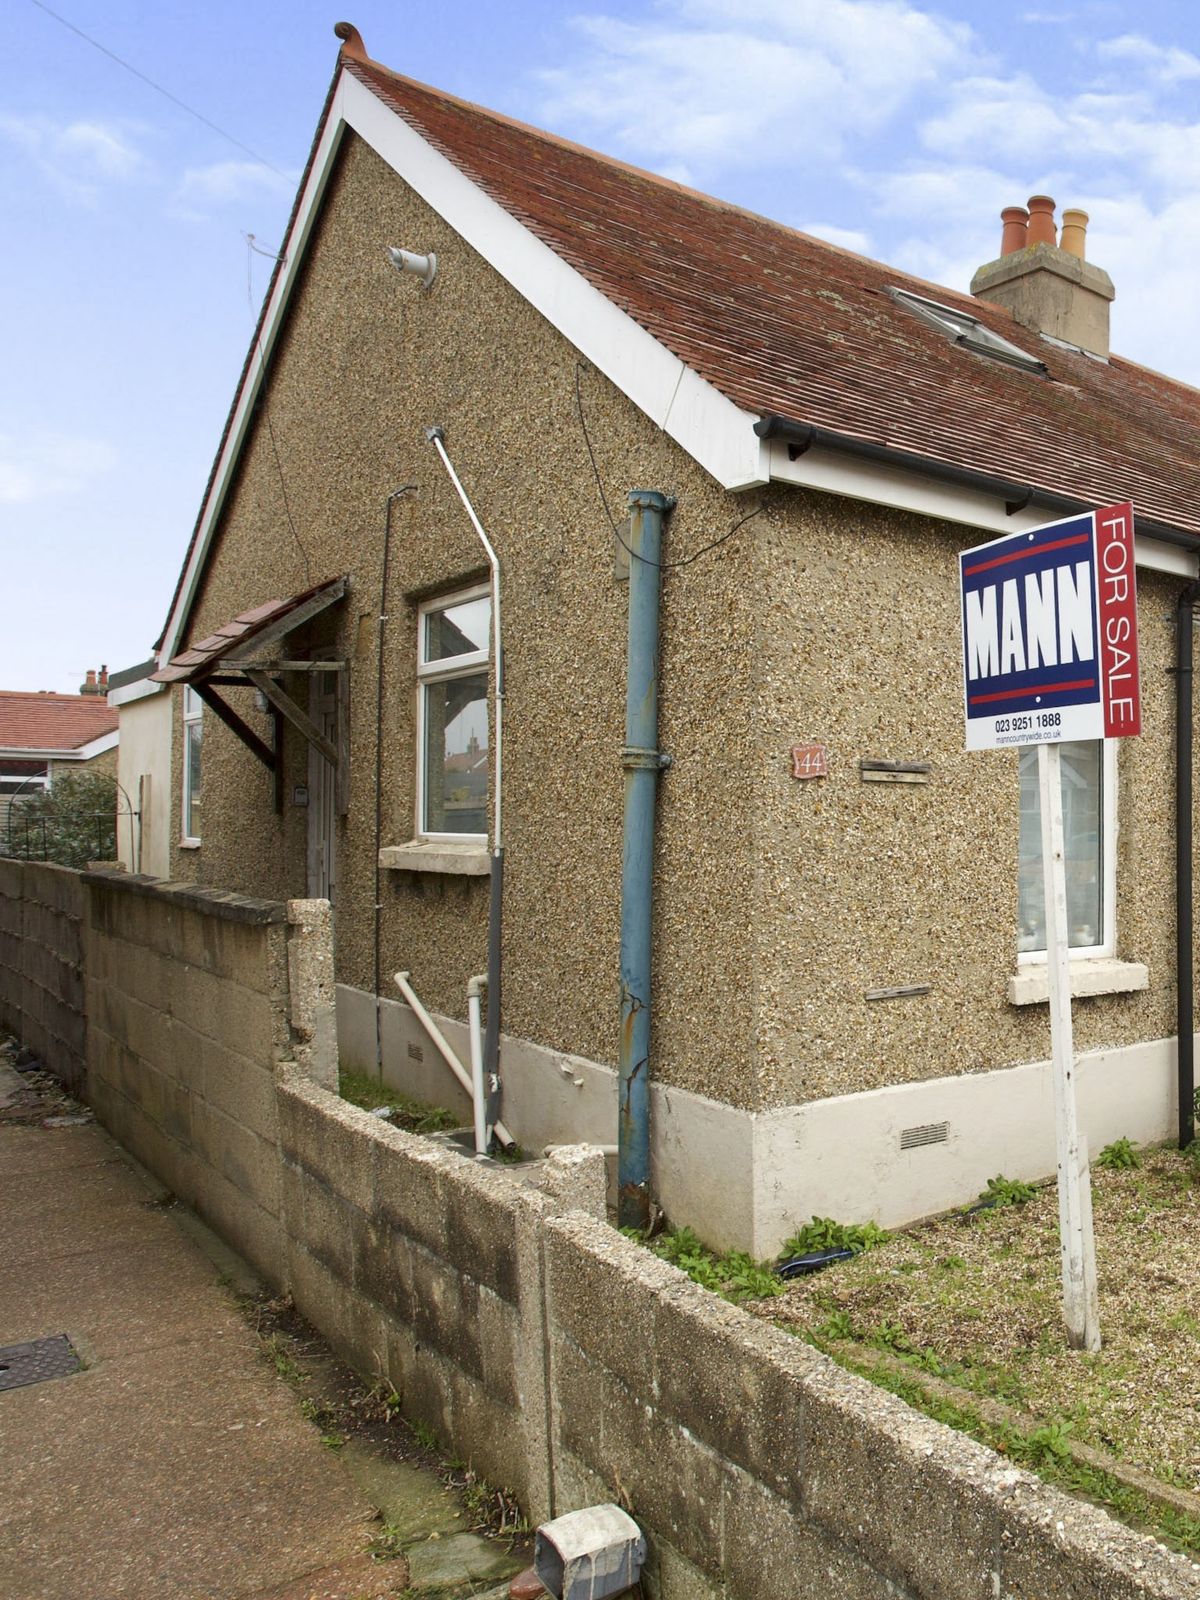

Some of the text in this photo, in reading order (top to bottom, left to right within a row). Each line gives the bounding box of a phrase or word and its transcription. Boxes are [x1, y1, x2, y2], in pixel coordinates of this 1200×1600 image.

[965, 560, 1094, 681] MANN
[1102, 516, 1134, 724] FOR SALE
[995, 712, 1062, 733] 023 9251 1888
[996, 729, 1062, 743] manncountrywide.co.uk
[800, 751, 822, 773] 44
